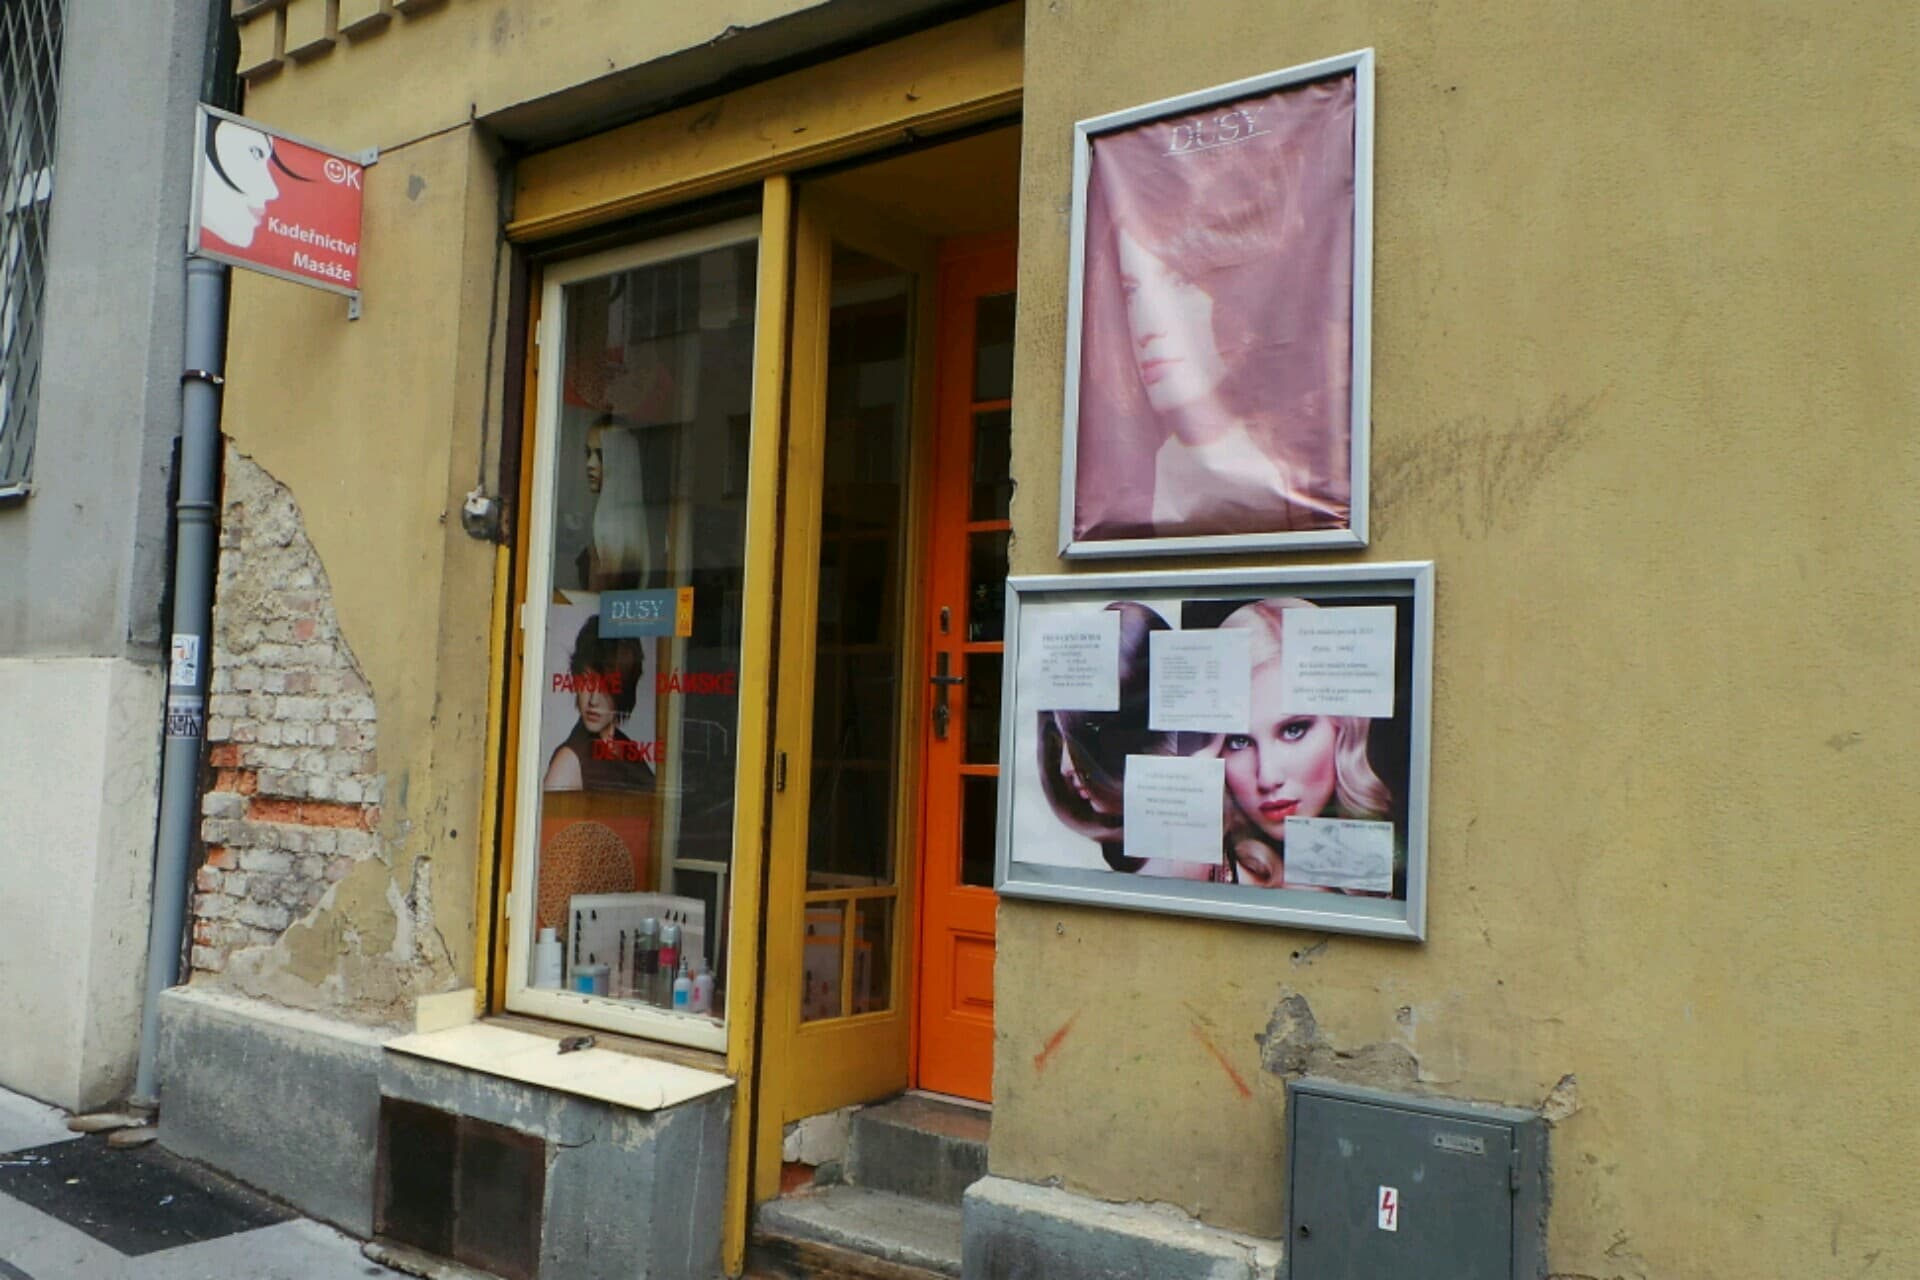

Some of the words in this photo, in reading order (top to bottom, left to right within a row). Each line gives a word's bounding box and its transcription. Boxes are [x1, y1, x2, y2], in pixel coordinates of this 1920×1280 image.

[1169, 107, 1264, 151] DUSY
[293, 251, 353, 281] Masáže
[611, 599, 664, 620] DUSY
[656, 668, 736, 694] DÁMSKÉ
